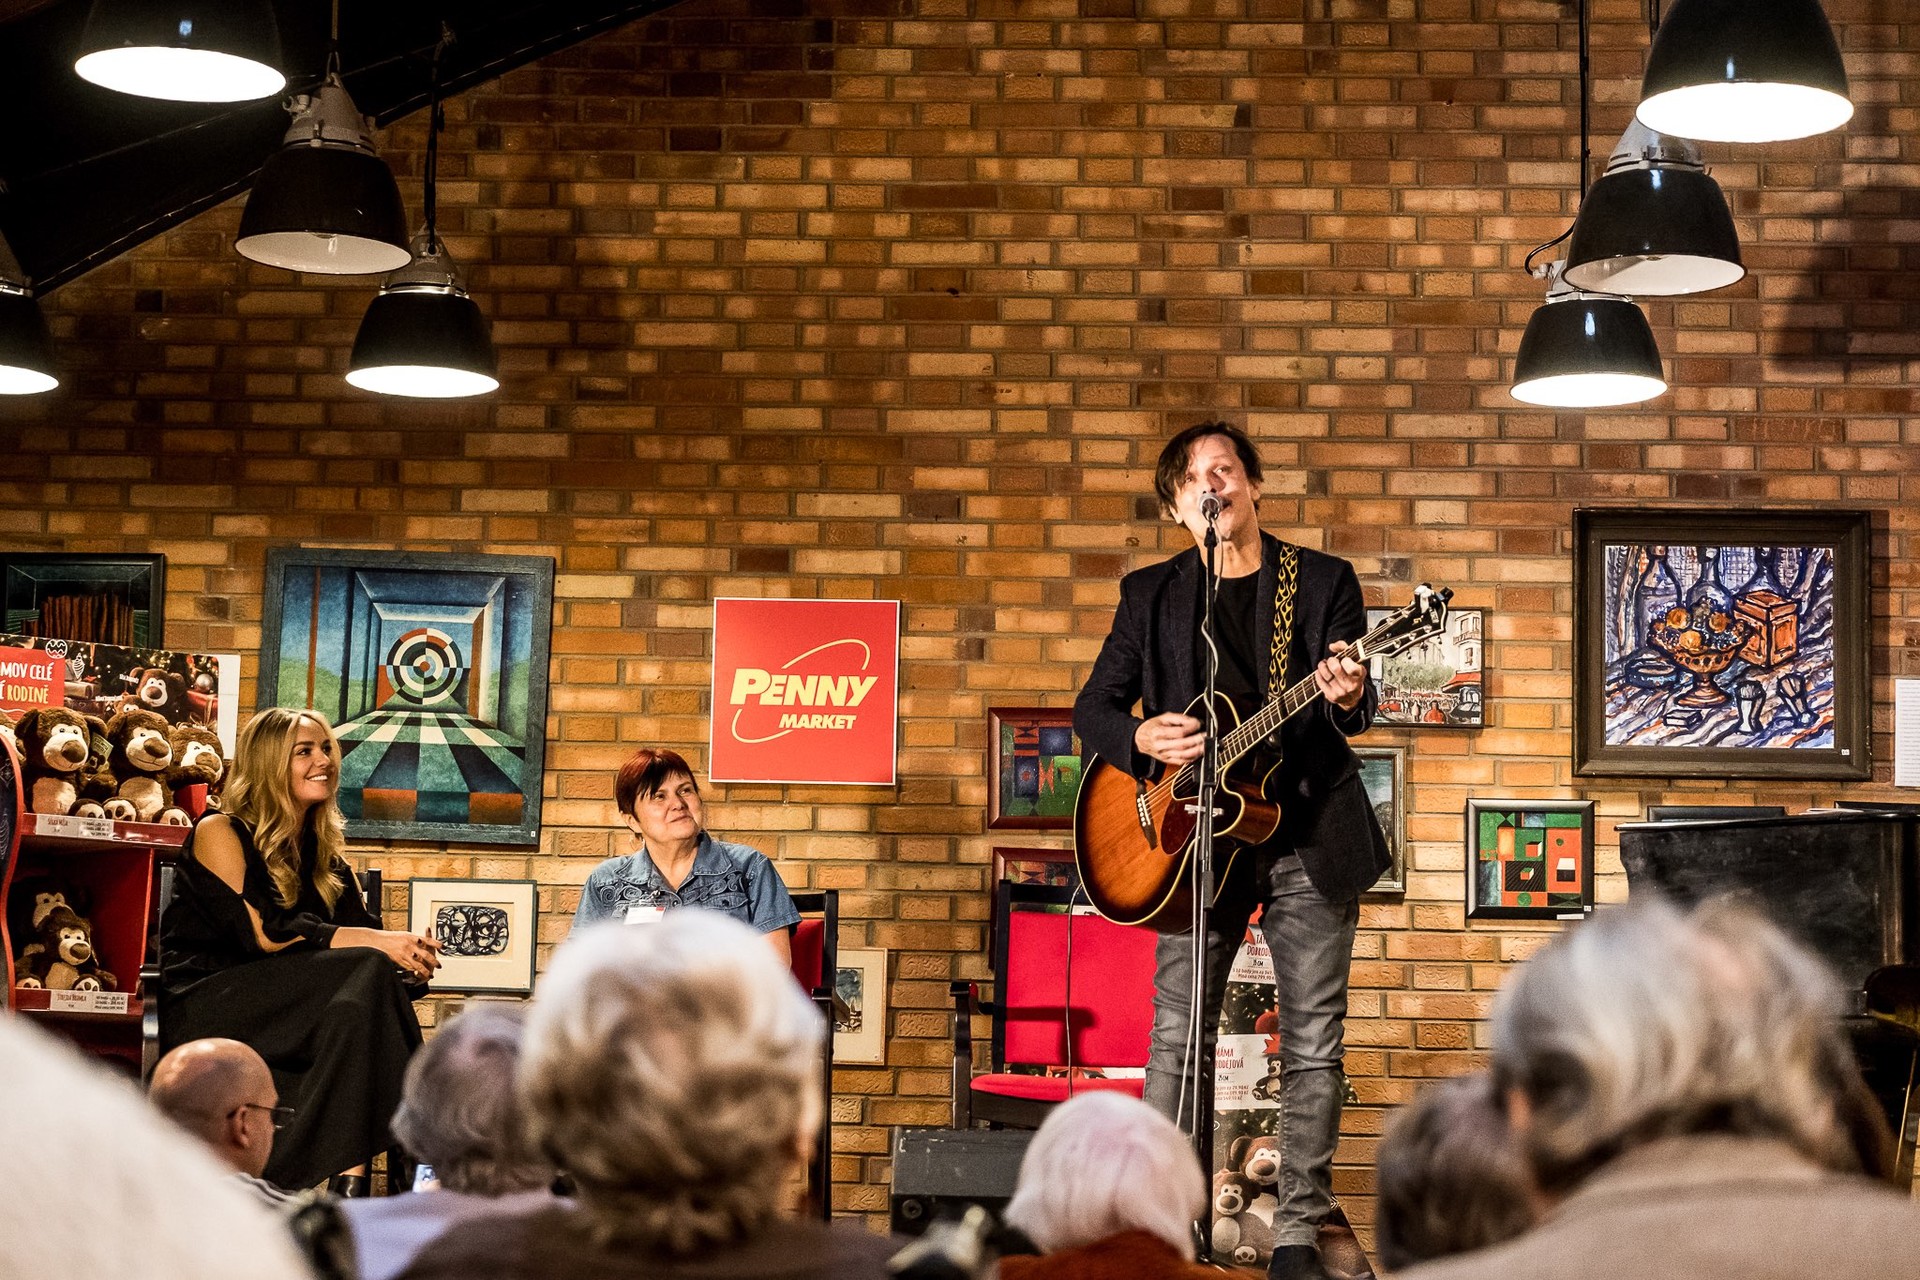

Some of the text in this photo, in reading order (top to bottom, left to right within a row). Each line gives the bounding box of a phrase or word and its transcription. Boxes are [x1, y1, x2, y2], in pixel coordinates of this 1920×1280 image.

[29, 662, 55, 681] CELÉ
[7, 684, 50, 705] RODINĚ
[730, 668, 878, 707] PENNY
[779, 714, 857, 730] MARKET
